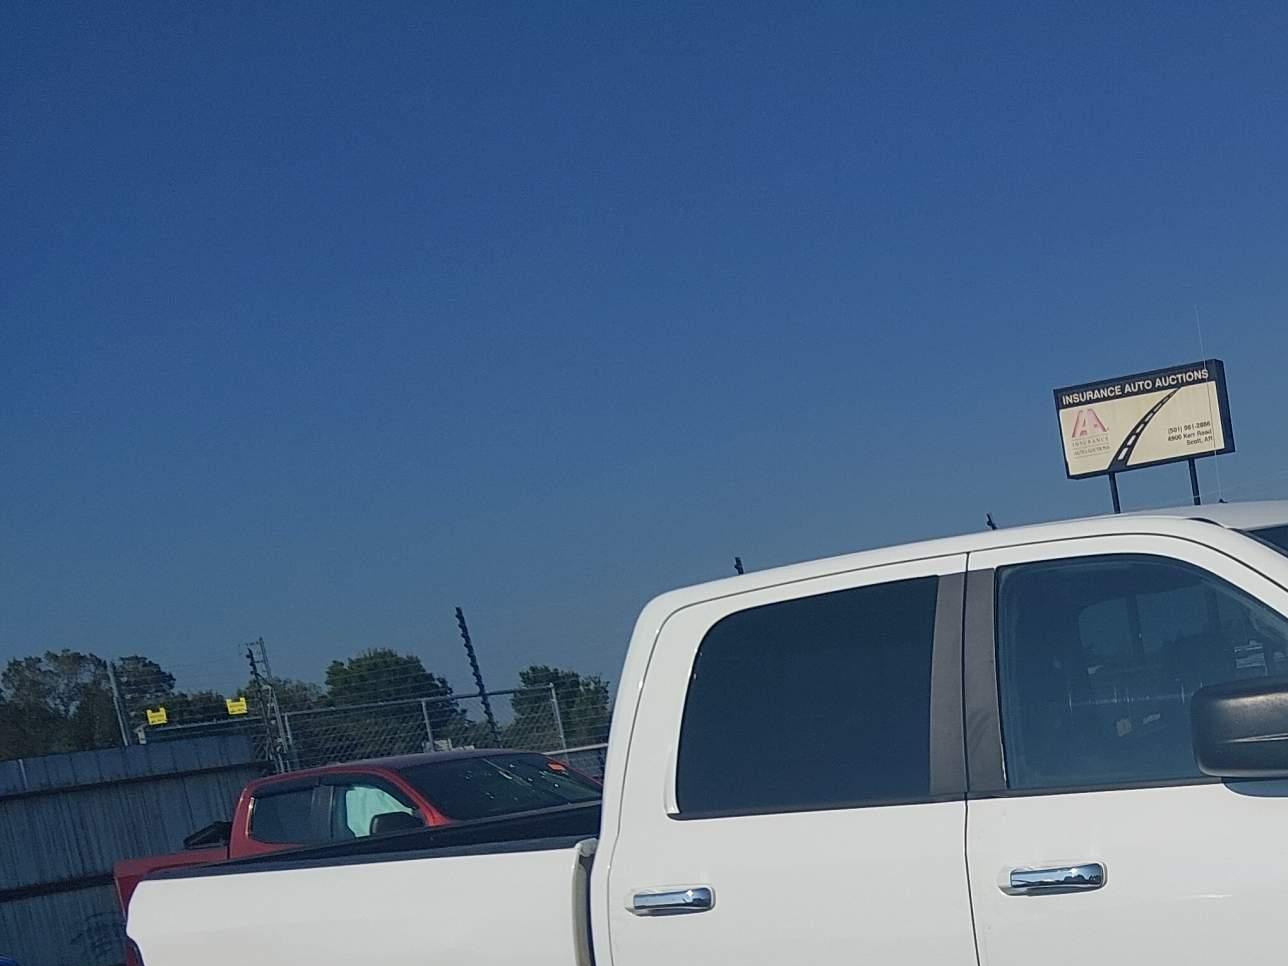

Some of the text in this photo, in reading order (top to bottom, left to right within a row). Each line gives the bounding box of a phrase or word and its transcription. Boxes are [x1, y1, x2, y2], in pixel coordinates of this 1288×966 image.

[1062, 368, 1209, 406] INSURANCE AUTO AUCTIONS
